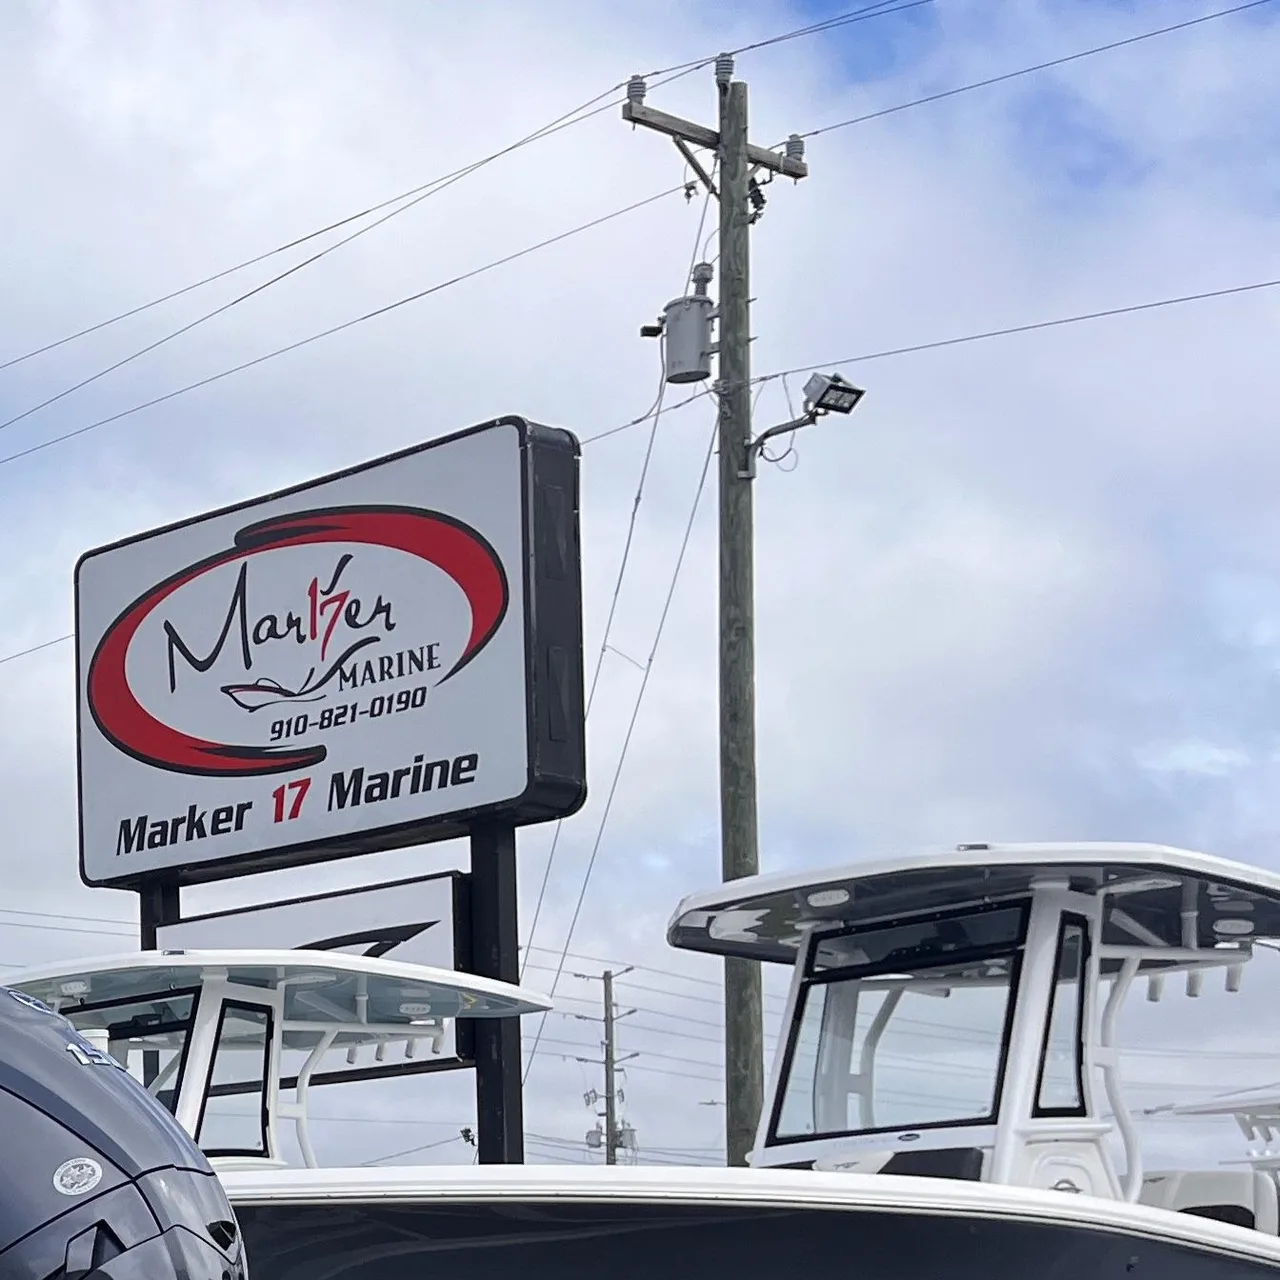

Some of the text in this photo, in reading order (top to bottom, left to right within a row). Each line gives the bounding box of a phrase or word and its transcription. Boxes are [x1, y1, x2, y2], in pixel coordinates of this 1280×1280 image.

[338, 642, 441, 692] MARINE
[269, 685, 428, 741] 910-821-0190
[116, 752, 479, 856] Marker 17 Marine
